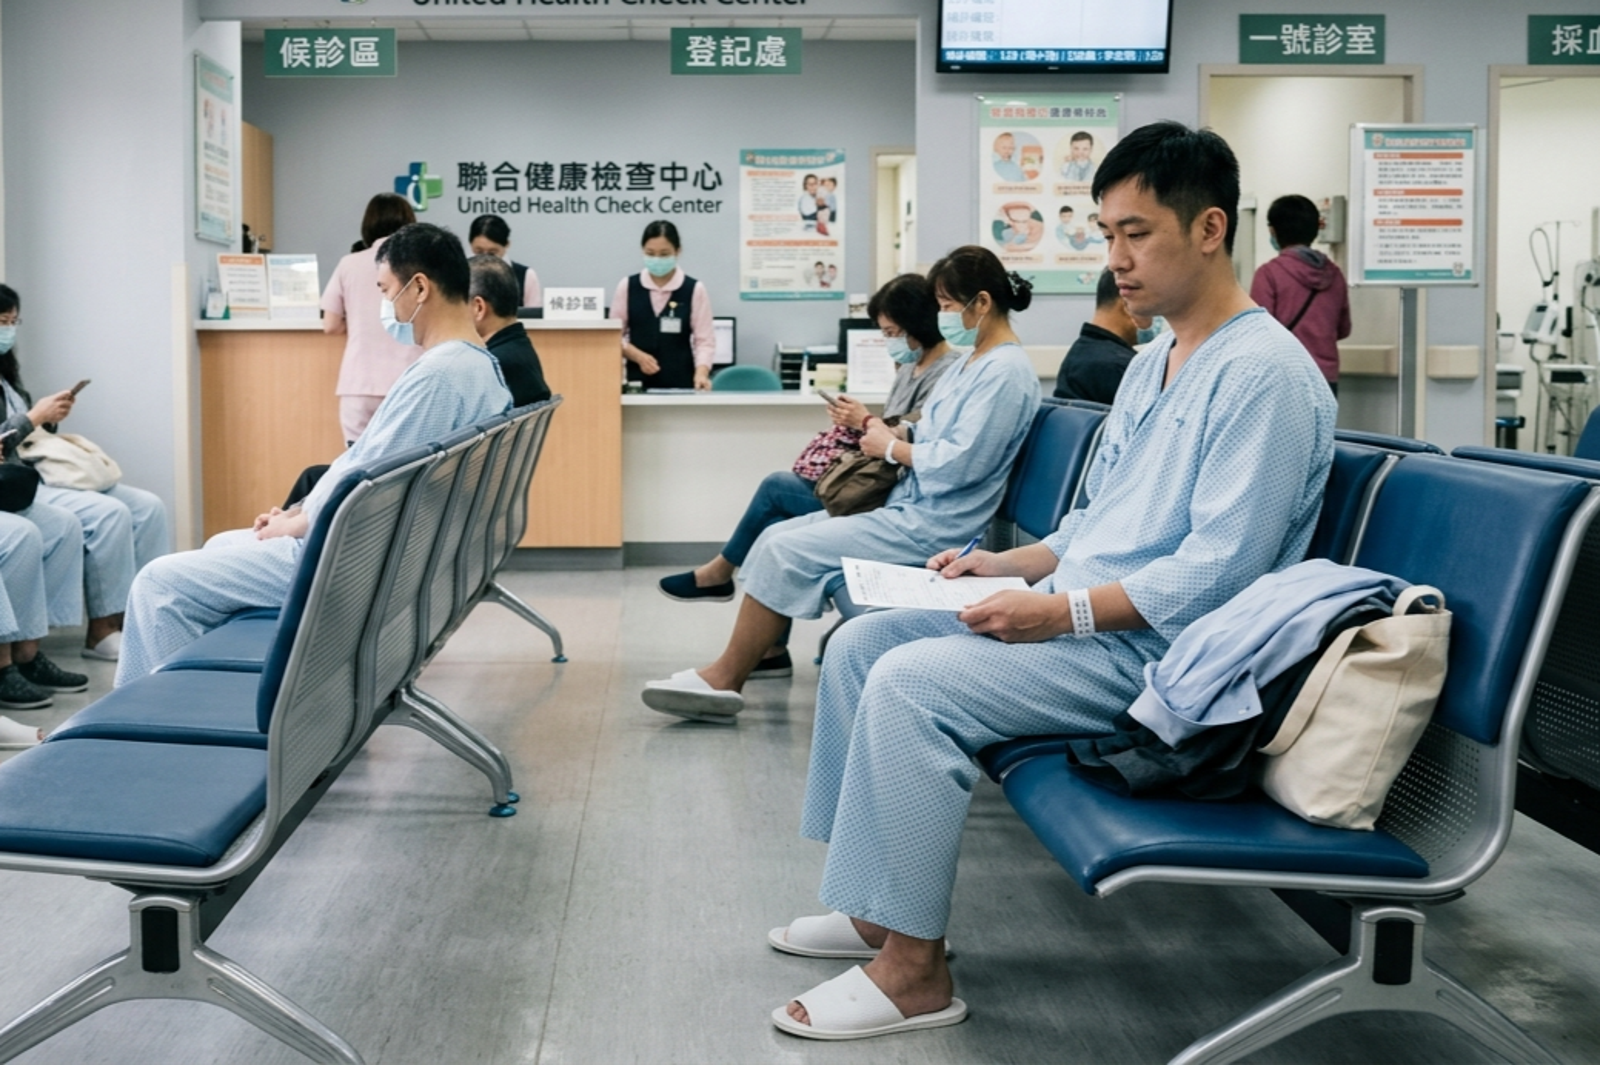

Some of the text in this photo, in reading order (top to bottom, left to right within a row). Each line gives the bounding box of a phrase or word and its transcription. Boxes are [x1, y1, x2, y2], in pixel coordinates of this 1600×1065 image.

[279, 35, 380, 68] 候診區
[686, 35, 787, 67] 登記處
[1249, 23, 1377, 56] 一號診室
[456, 161, 723, 192] 聯合健康檢查中心
[457, 196, 723, 214] United Health Check Center
